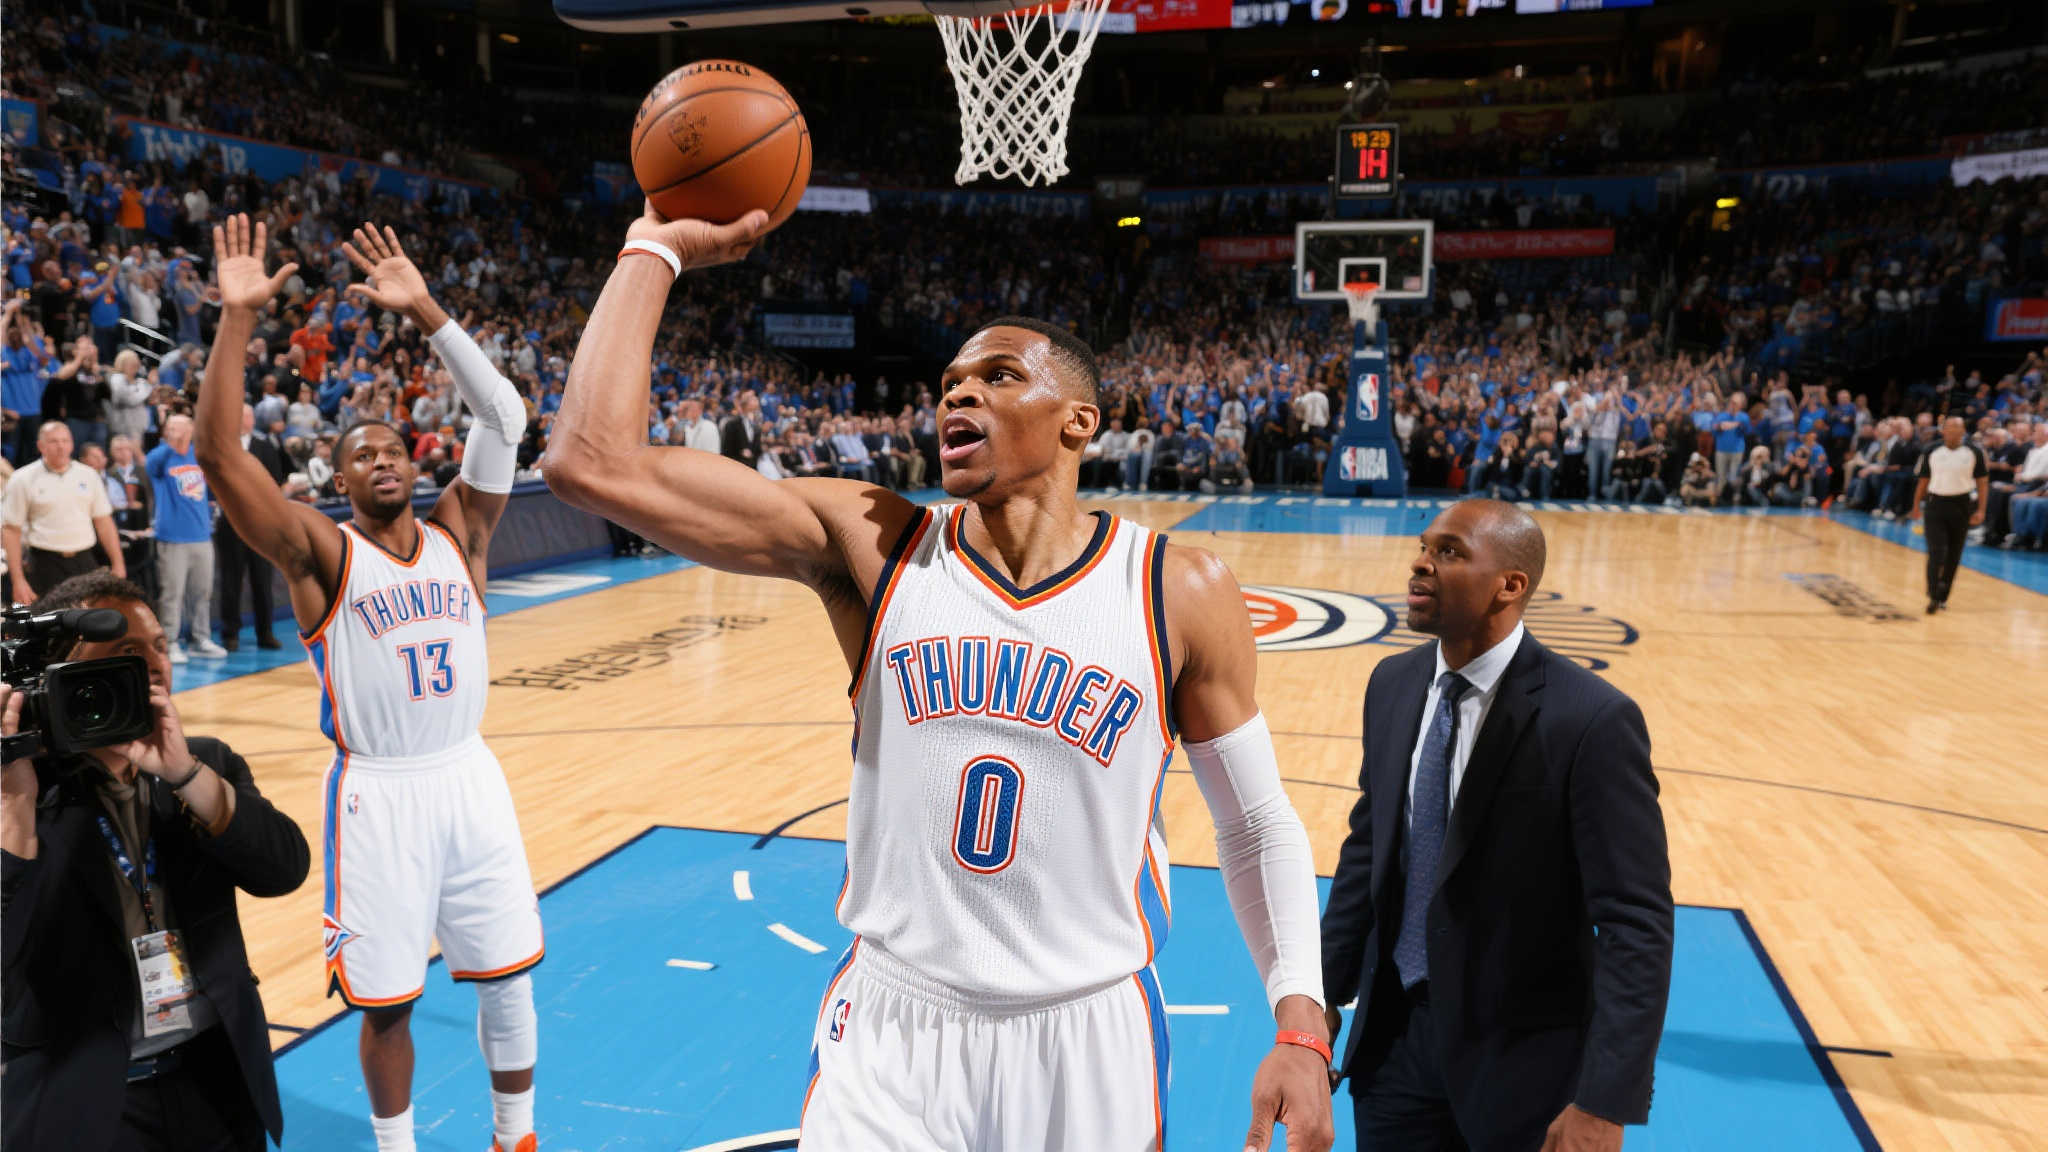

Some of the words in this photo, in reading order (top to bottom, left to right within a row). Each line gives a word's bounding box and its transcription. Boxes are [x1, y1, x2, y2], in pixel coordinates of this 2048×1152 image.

[351, 578, 471, 640] THUNDER
[396, 637, 457, 702] 13
[887, 635, 1144, 769] THUNDER
[951, 753, 1026, 875] 0
